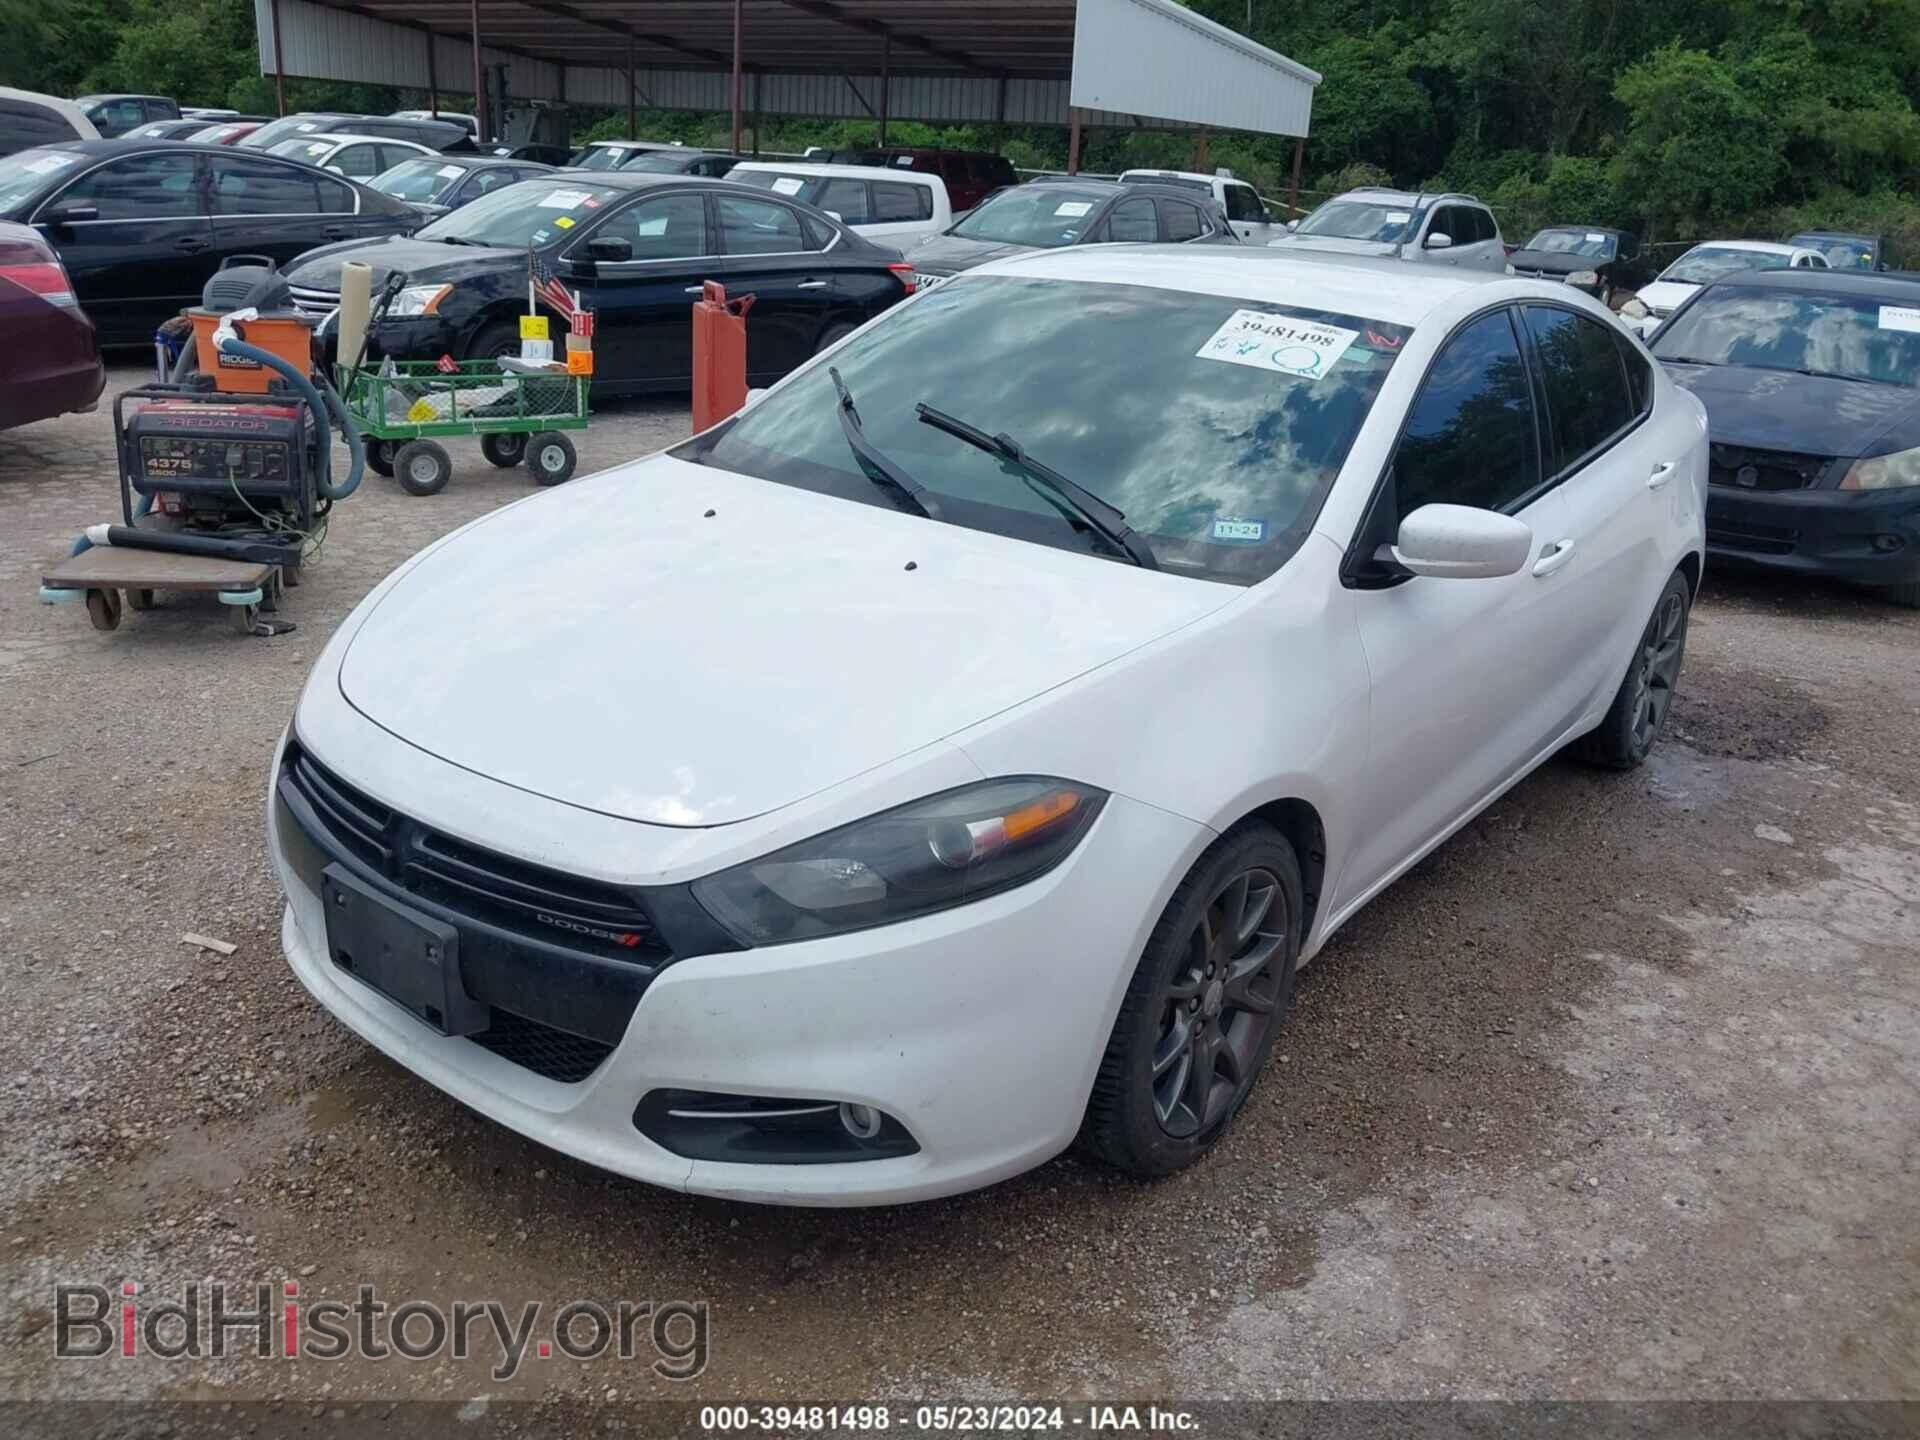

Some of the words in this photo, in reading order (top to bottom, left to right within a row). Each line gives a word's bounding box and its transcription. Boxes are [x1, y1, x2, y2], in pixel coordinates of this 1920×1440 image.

[1239, 320, 1336, 347] 39481498
[158, 416, 269, 431] PREDATOR
[147, 458, 193, 470] 4375
[536, 913, 625, 942] DODGE
